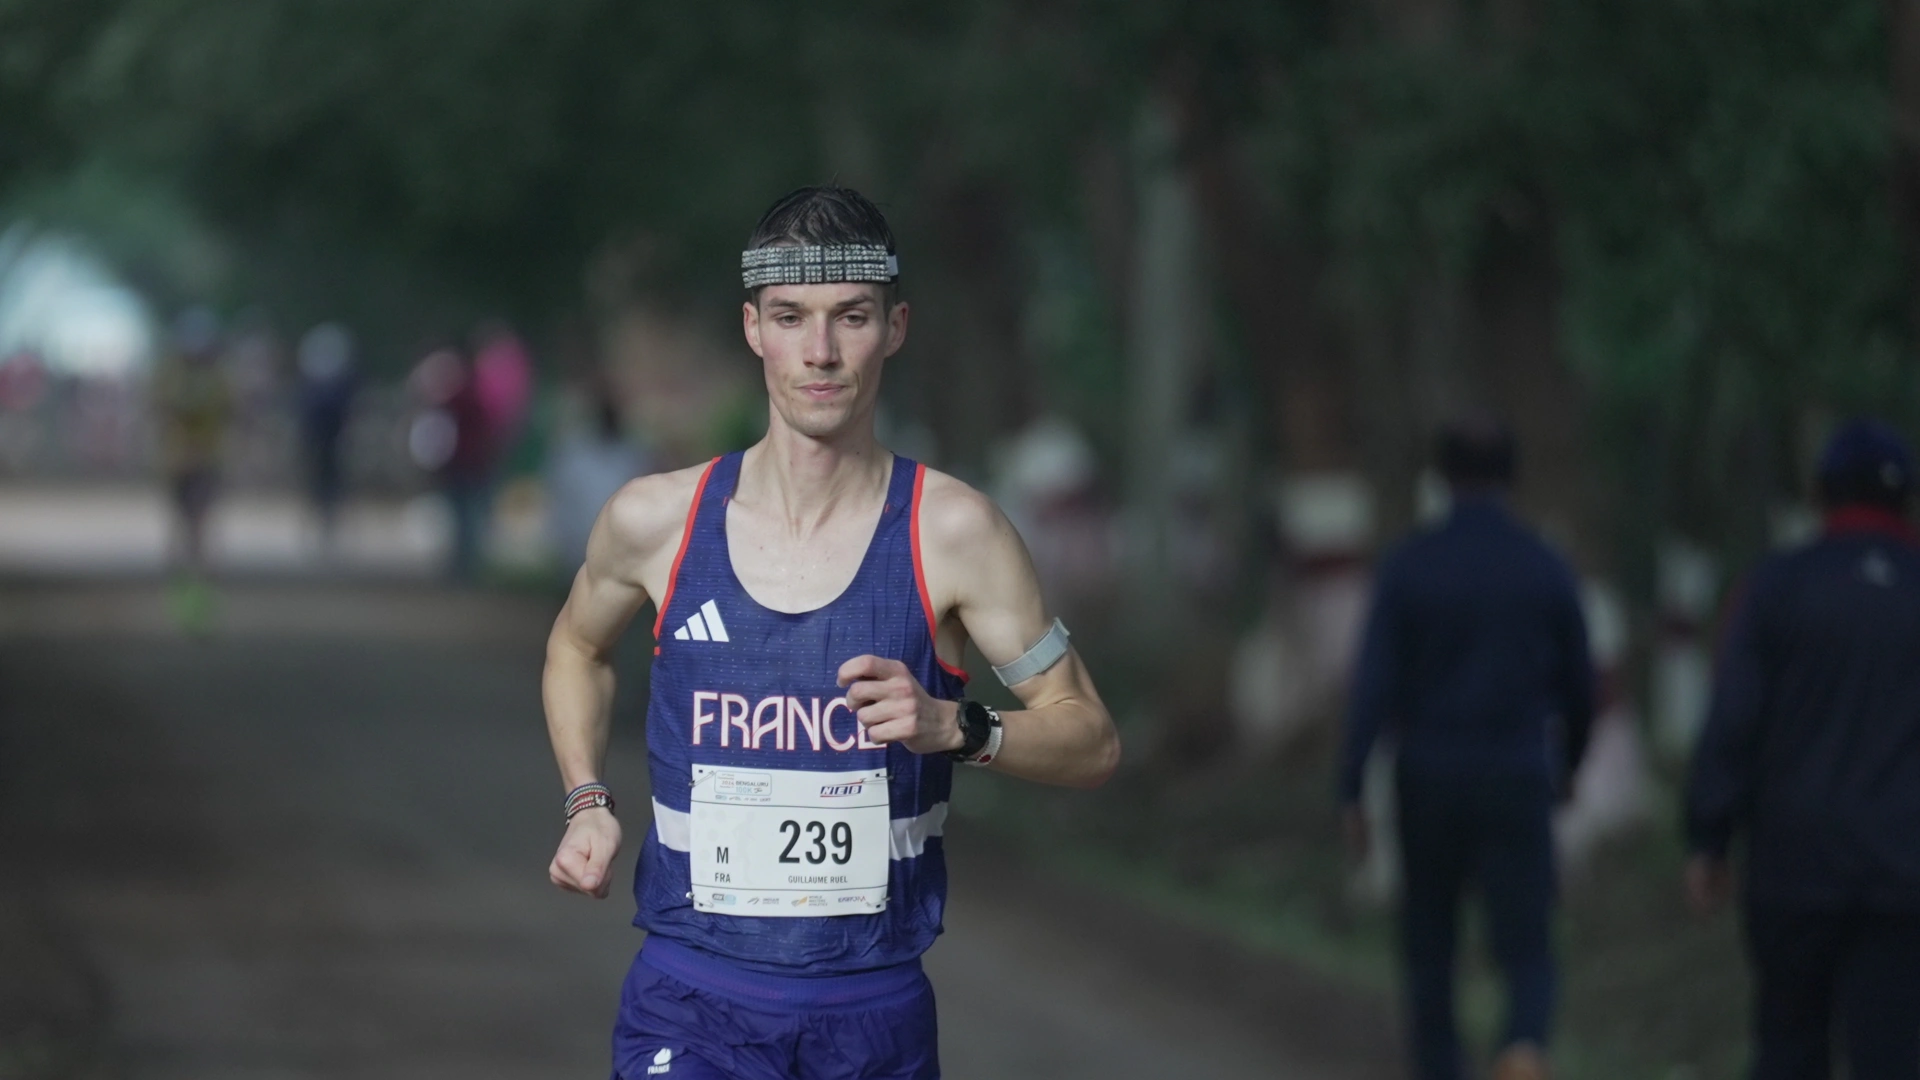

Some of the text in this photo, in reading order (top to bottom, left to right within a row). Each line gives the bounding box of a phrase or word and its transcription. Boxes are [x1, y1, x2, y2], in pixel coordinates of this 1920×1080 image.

[735, 780, 769, 788] BENGALURU
[820, 785, 863, 795] NEB
[778, 819, 853, 865] 239
[716, 846, 730, 865] M
[714, 872, 731, 884] FRA
[787, 875, 848, 885] GUILLAUME RUEL
